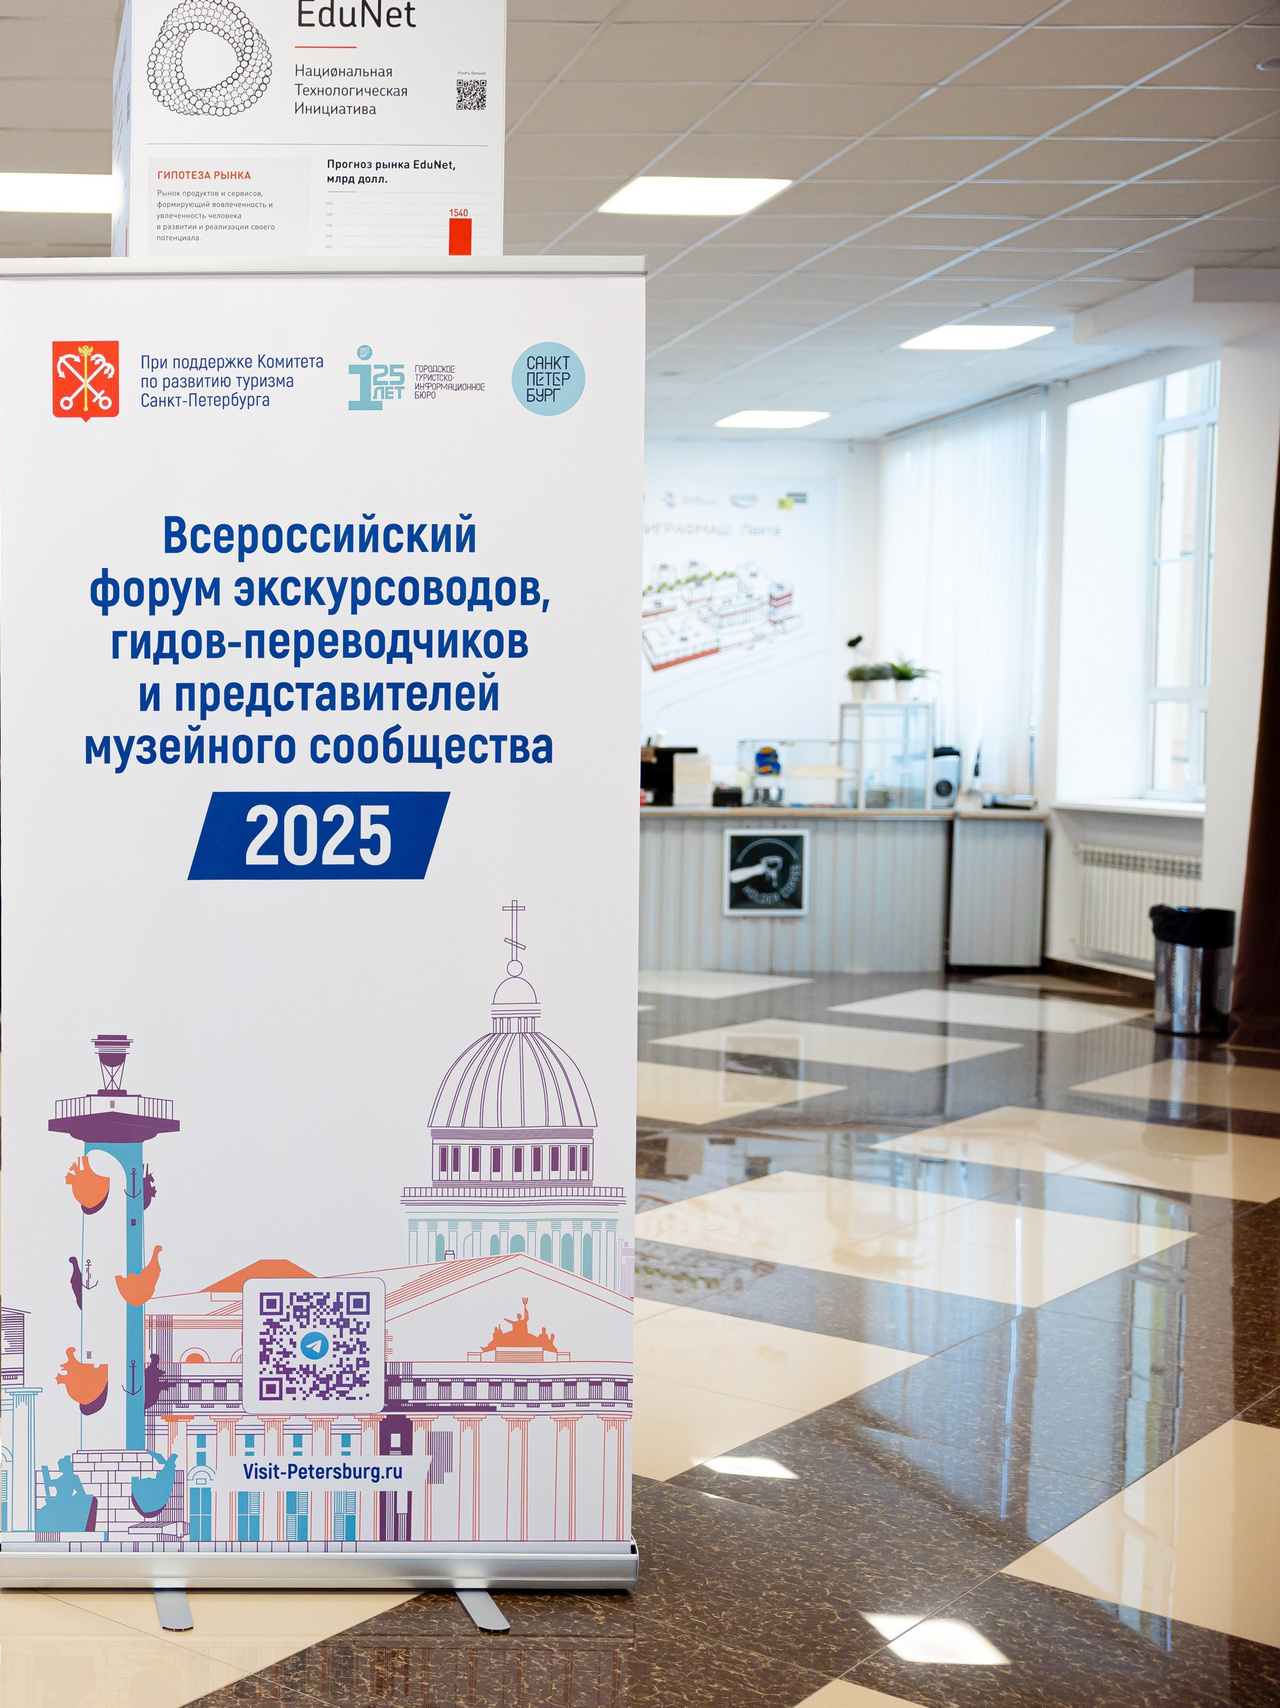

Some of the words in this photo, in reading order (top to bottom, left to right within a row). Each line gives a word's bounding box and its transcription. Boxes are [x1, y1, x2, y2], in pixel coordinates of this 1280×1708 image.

[297, 0, 417, 28] EduNet
[294, 83, 408, 97] Технологическая
[294, 102, 377, 117] Инициатива
[327, 159, 372, 171] Прогноз
[375, 161, 410, 171] рынка
[413, 160, 456, 171] EduNet,
[157, 170, 211, 179] ГИПОТЕЗА
[213, 170, 251, 179] РЫНКА
[326, 175, 356, 185] млрд
[357, 175, 388, 184] долл.
[157, 189, 181, 197] Рынок
[182, 190, 219, 198] продуктов
[156, 200, 210, 209] формирующий
[449, 209, 469, 217] 1540
[162, 224, 197, 232] развитии
[205, 224, 250, 232] реализации
[141, 354, 168, 372] При
[172, 356, 253, 371] поддержке
[257, 354, 324, 369] Комитета
[414, 364, 456, 373] ГОРОДСКОЕ
[526, 355, 570, 370] САНКТ
[141, 376, 158, 388] по
[162, 376, 232, 391] развитию
[236, 375, 294, 391] туризма
[526, 371, 571, 386] ПЕТЕР
[372, 387, 405, 400] ЛЕТ
[414, 383, 486, 391] ИНФОРМАЦИОННОЕ
[141, 391, 270, 410] Санкт-Петербурга
[414, 391, 437, 400] БЮРО
[526, 388, 561, 402] БУРГ
[163, 513, 477, 563] Всероссийский
[90, 567, 221, 616] форум
[233, 575, 550, 614] экскурсоводов,
[110, 628, 529, 668] гидов-переводчиков
[138, 681, 161, 712] и
[175, 671, 500, 721] представителей
[84, 724, 297, 774] музейного
[309, 723, 554, 770] сообщества
[244, 803, 392, 867] 2025
[243, 1462, 403, 1484] Visit-Petersburg.ru
